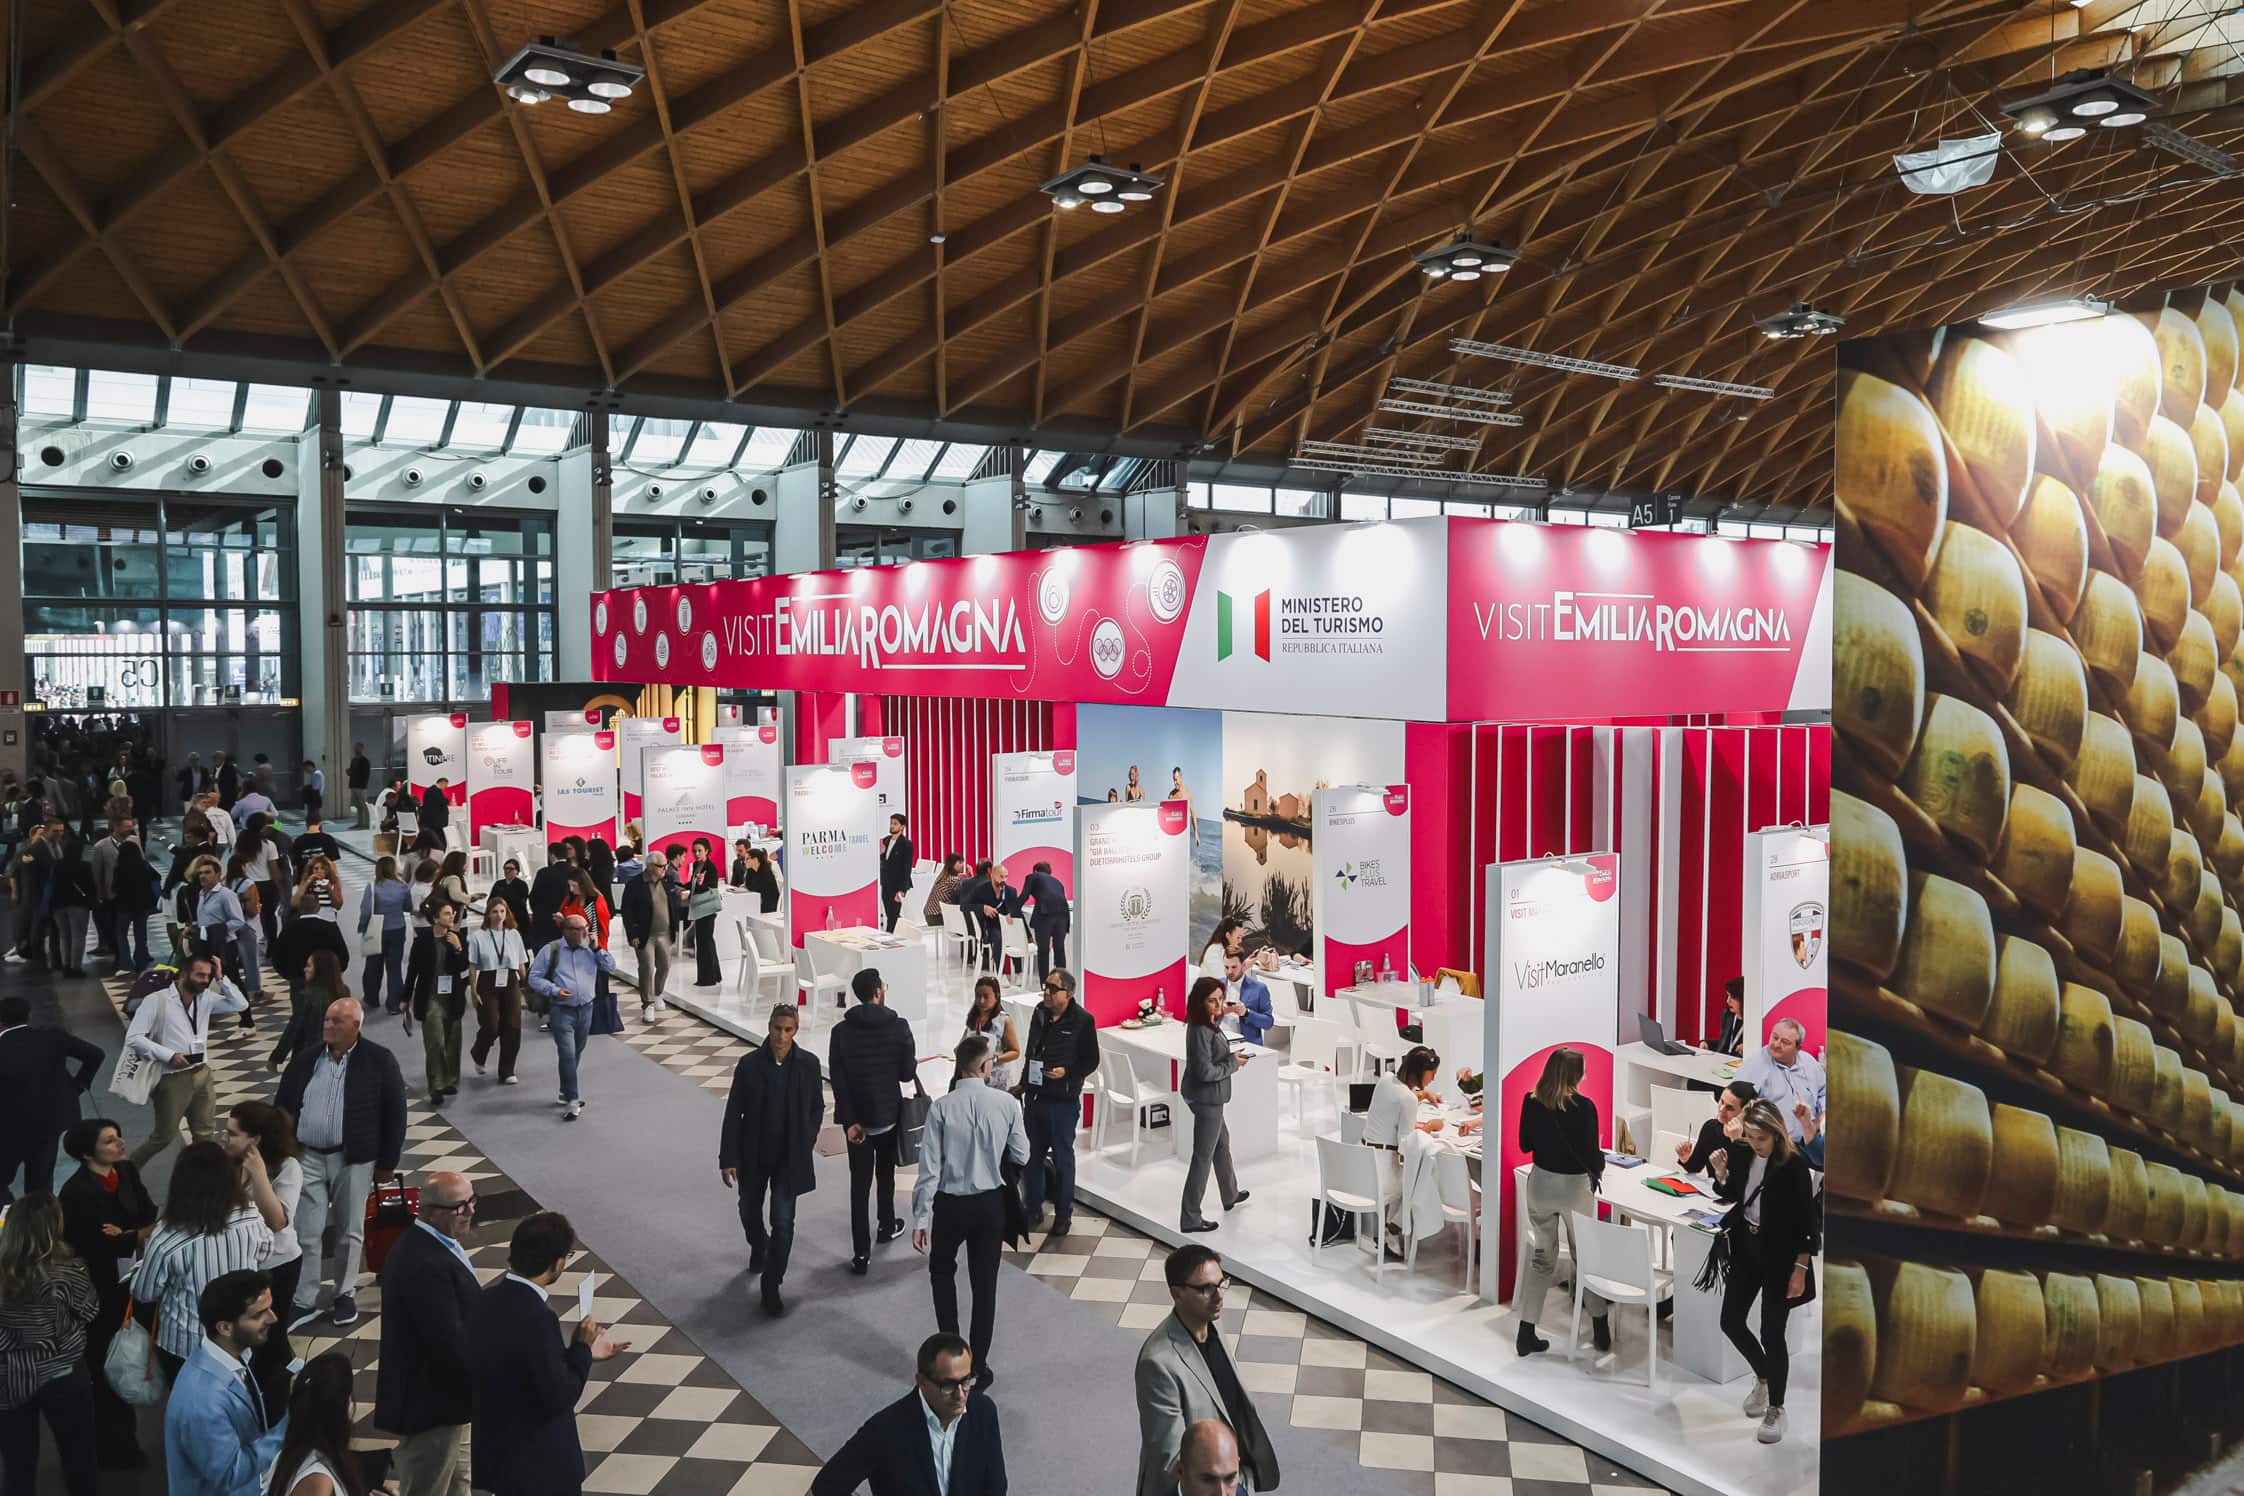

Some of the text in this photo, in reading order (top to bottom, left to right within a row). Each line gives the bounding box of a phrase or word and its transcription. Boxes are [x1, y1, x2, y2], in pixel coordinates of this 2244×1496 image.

[1631, 503, 1653, 526] A5
[1669, 508, 1674, 522] 1
[1281, 597, 1363, 614] MINISTERO
[1281, 617, 1384, 634] DEL TURISMO
[1282, 642, 1384, 655] REPUBBLICA ITALIANA
[1021, 807, 1063, 819] Firmatour
[802, 829, 847, 845] PARMA
[802, 843, 847, 856] WELCOME
[1360, 859, 1380, 870] BIKES
[1361, 877, 1387, 888] TRAVEL
[1510, 908, 1527, 920] VISIT
